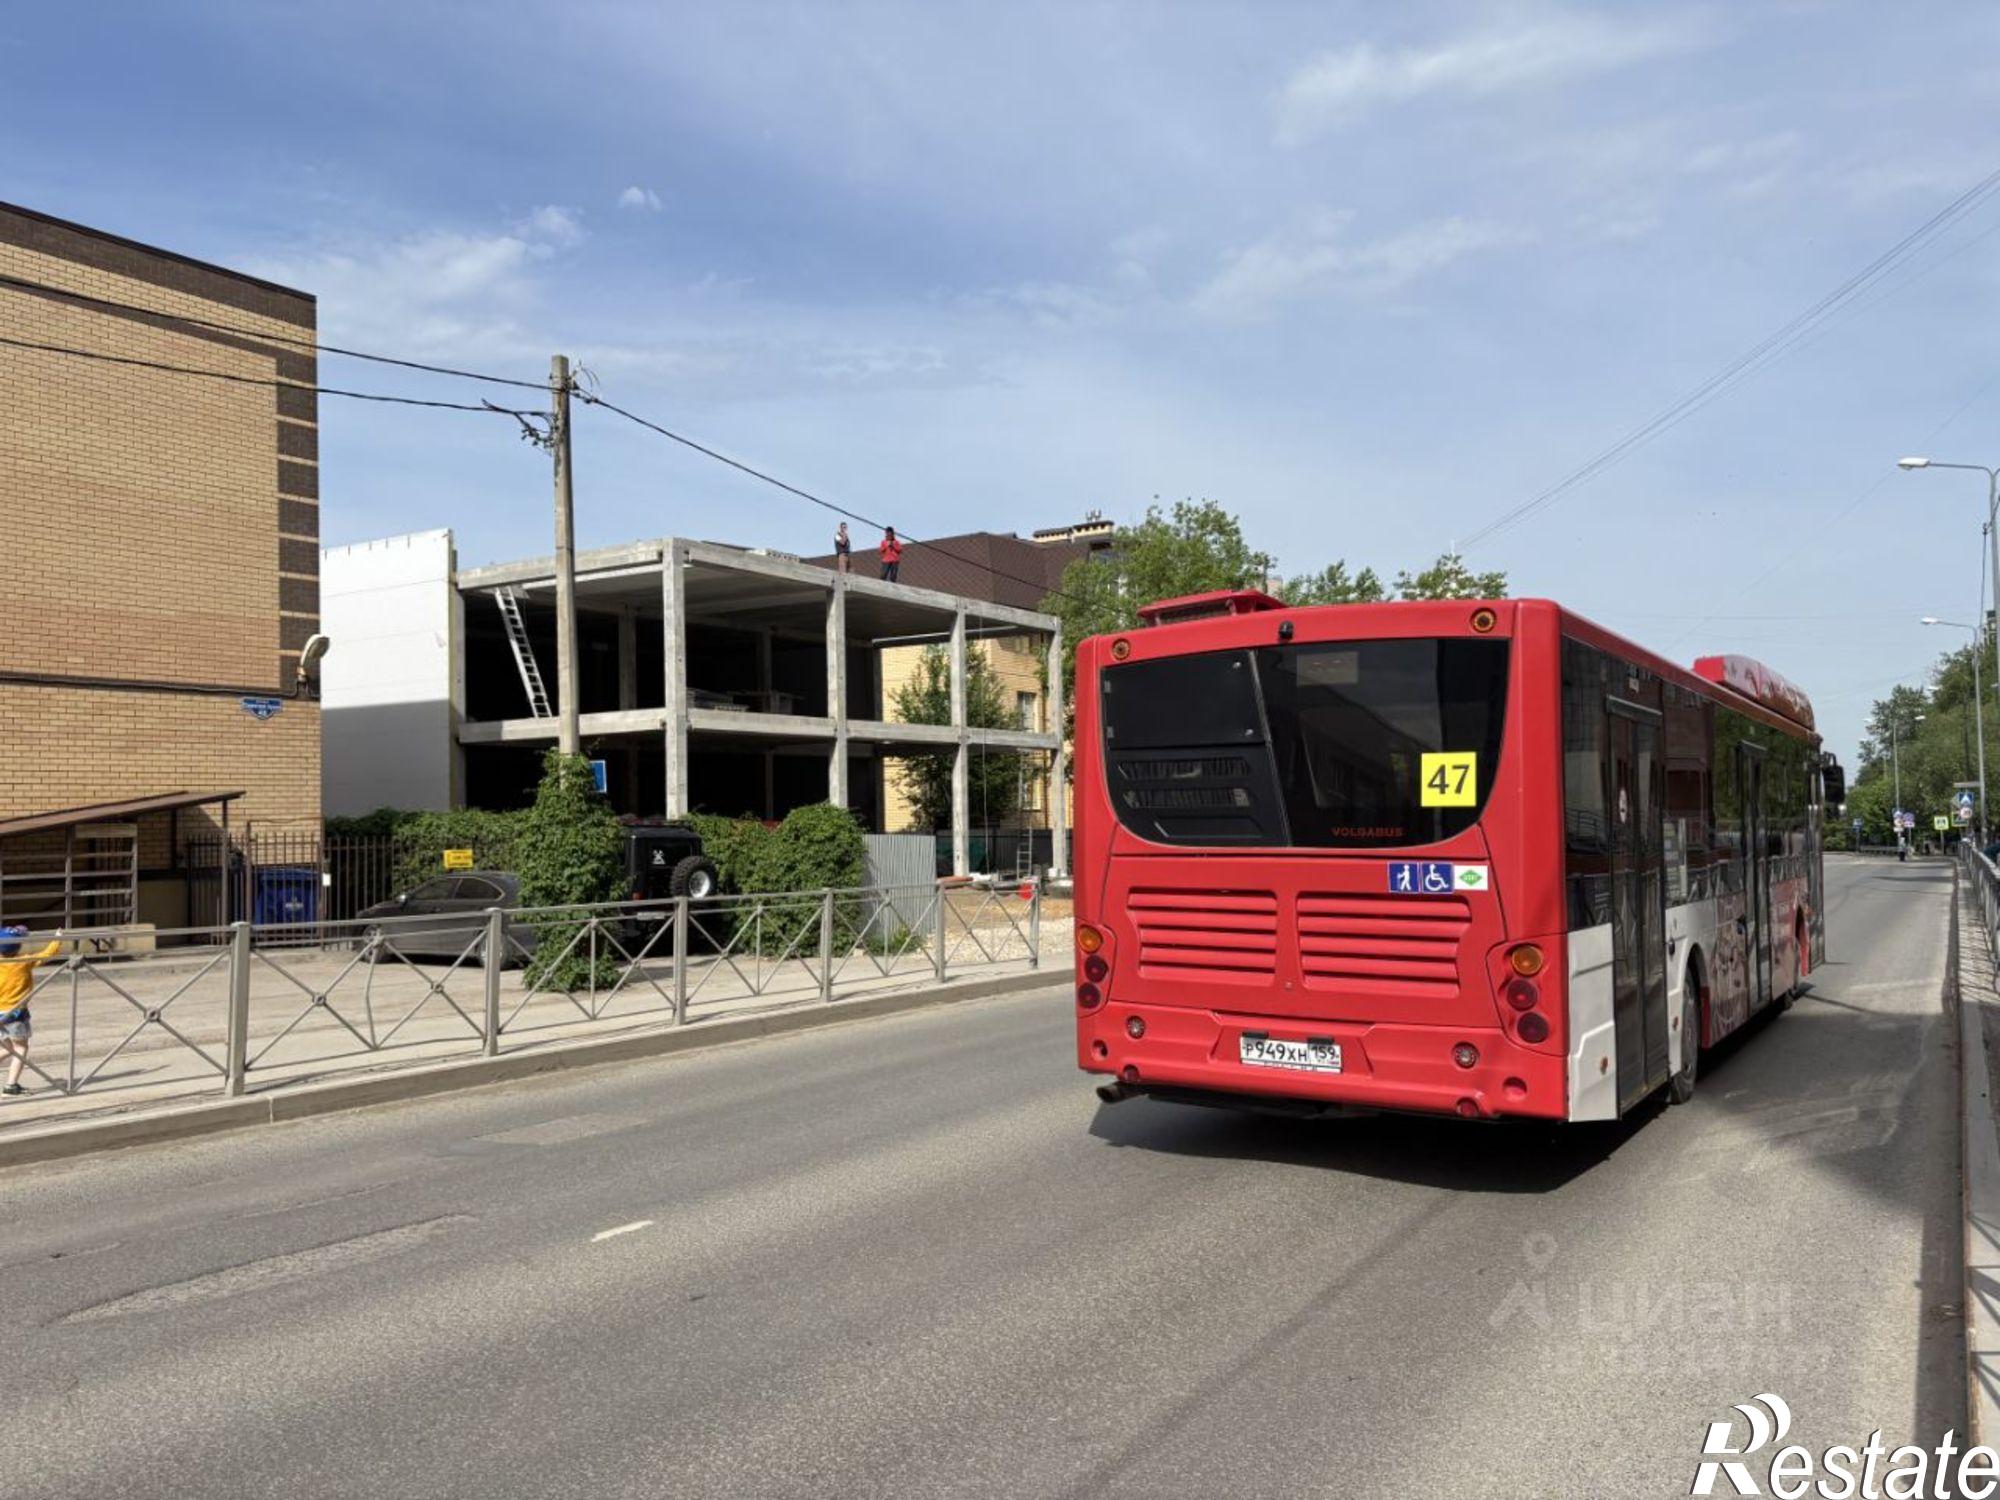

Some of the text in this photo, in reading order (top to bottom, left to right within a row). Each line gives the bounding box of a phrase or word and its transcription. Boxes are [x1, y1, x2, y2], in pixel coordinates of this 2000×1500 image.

[1427, 764, 1470, 795] 47
[1331, 827, 1404, 837] VOLGABUS
[1246, 1041, 1336, 1062] Р949ХН 159
